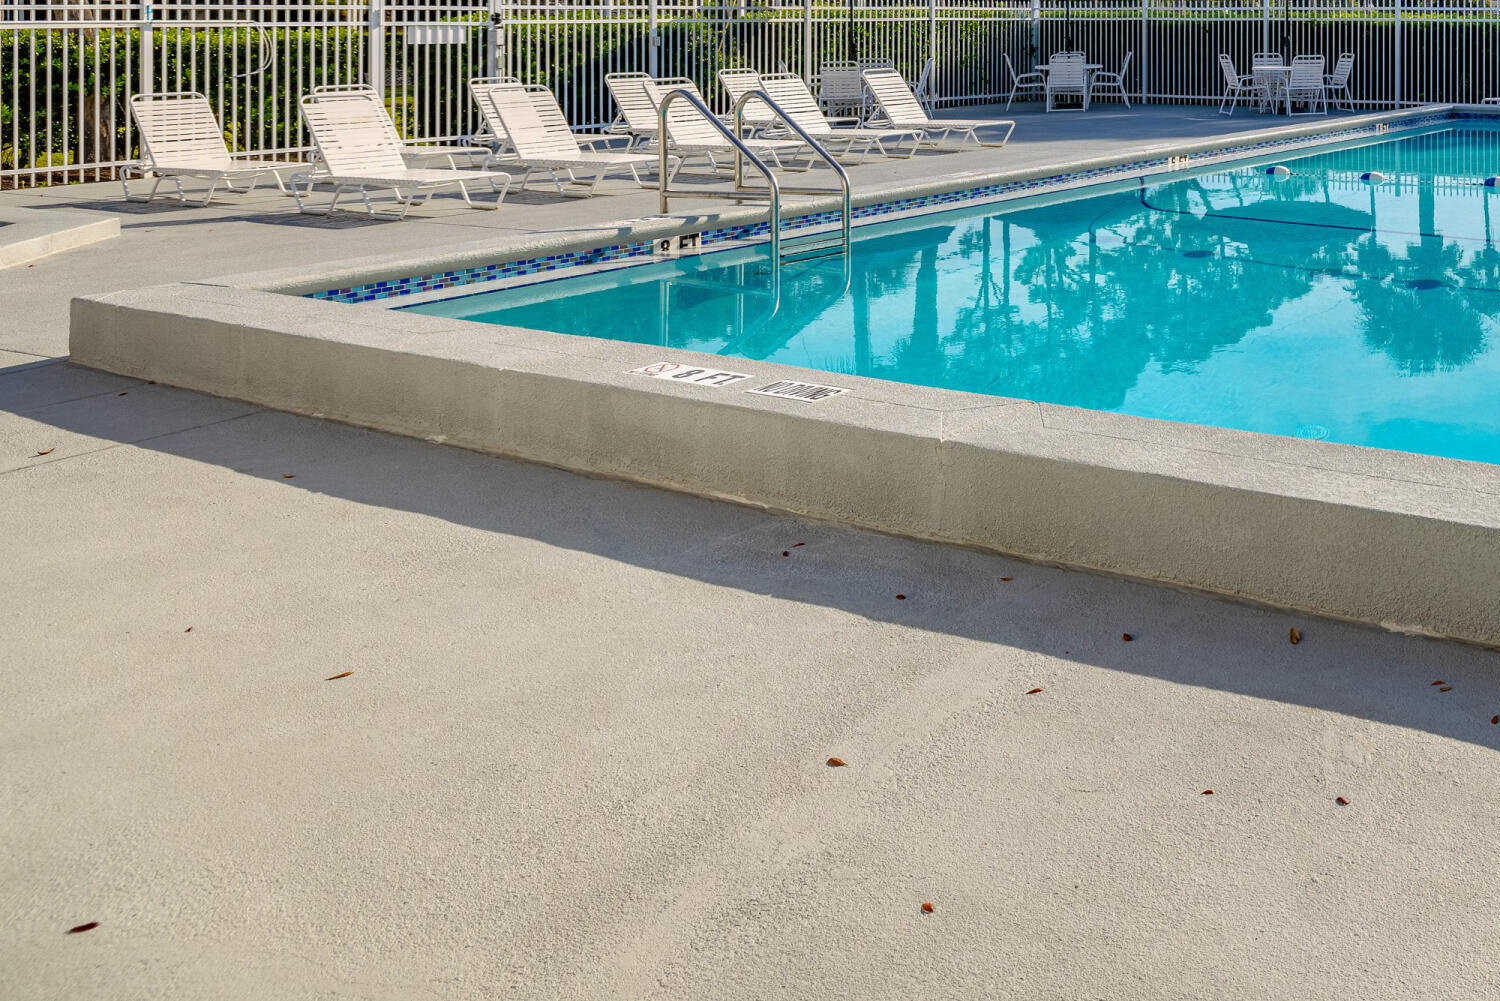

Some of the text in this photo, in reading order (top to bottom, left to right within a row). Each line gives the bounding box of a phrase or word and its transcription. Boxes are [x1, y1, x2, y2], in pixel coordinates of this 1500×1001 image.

[679, 232, 699, 249] FT
[671, 369, 705, 379] 8
[694, 372, 745, 386] FT
